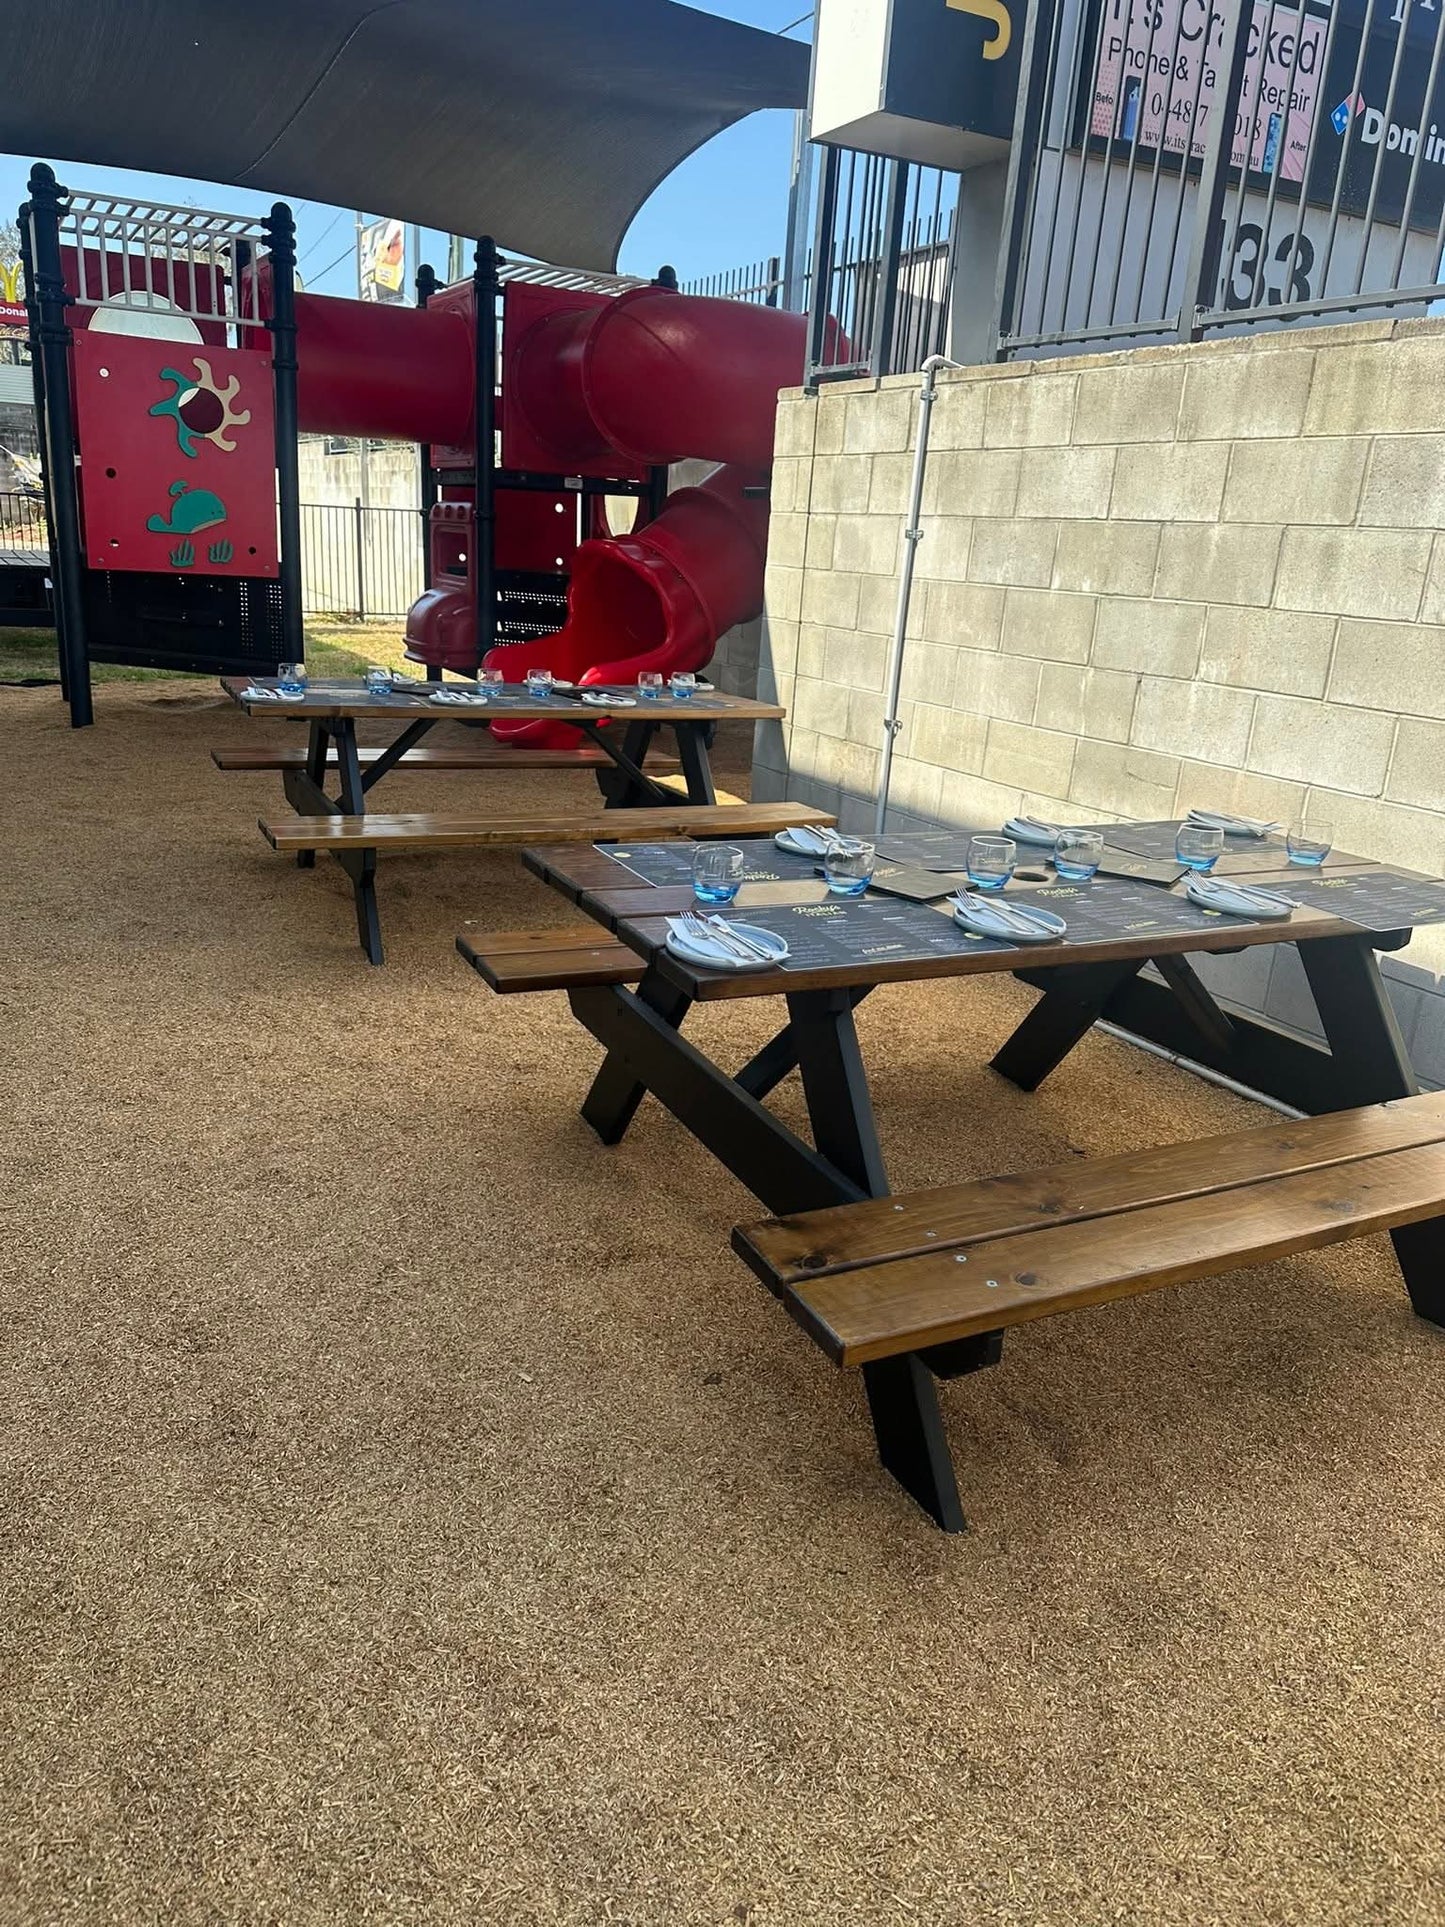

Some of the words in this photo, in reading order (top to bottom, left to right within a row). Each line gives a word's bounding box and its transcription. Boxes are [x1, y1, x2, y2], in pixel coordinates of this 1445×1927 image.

[1181, 0, 1320, 75] Crcked
[1108, 36, 1170, 76] Phone
[1175, 55, 1189, 81] &
[1096, 91, 1114, 105] Befo
[1151, 92, 1193, 123] 048
[1260, 78, 1310, 112] Repair
[1220, 219, 1315, 322] 33
